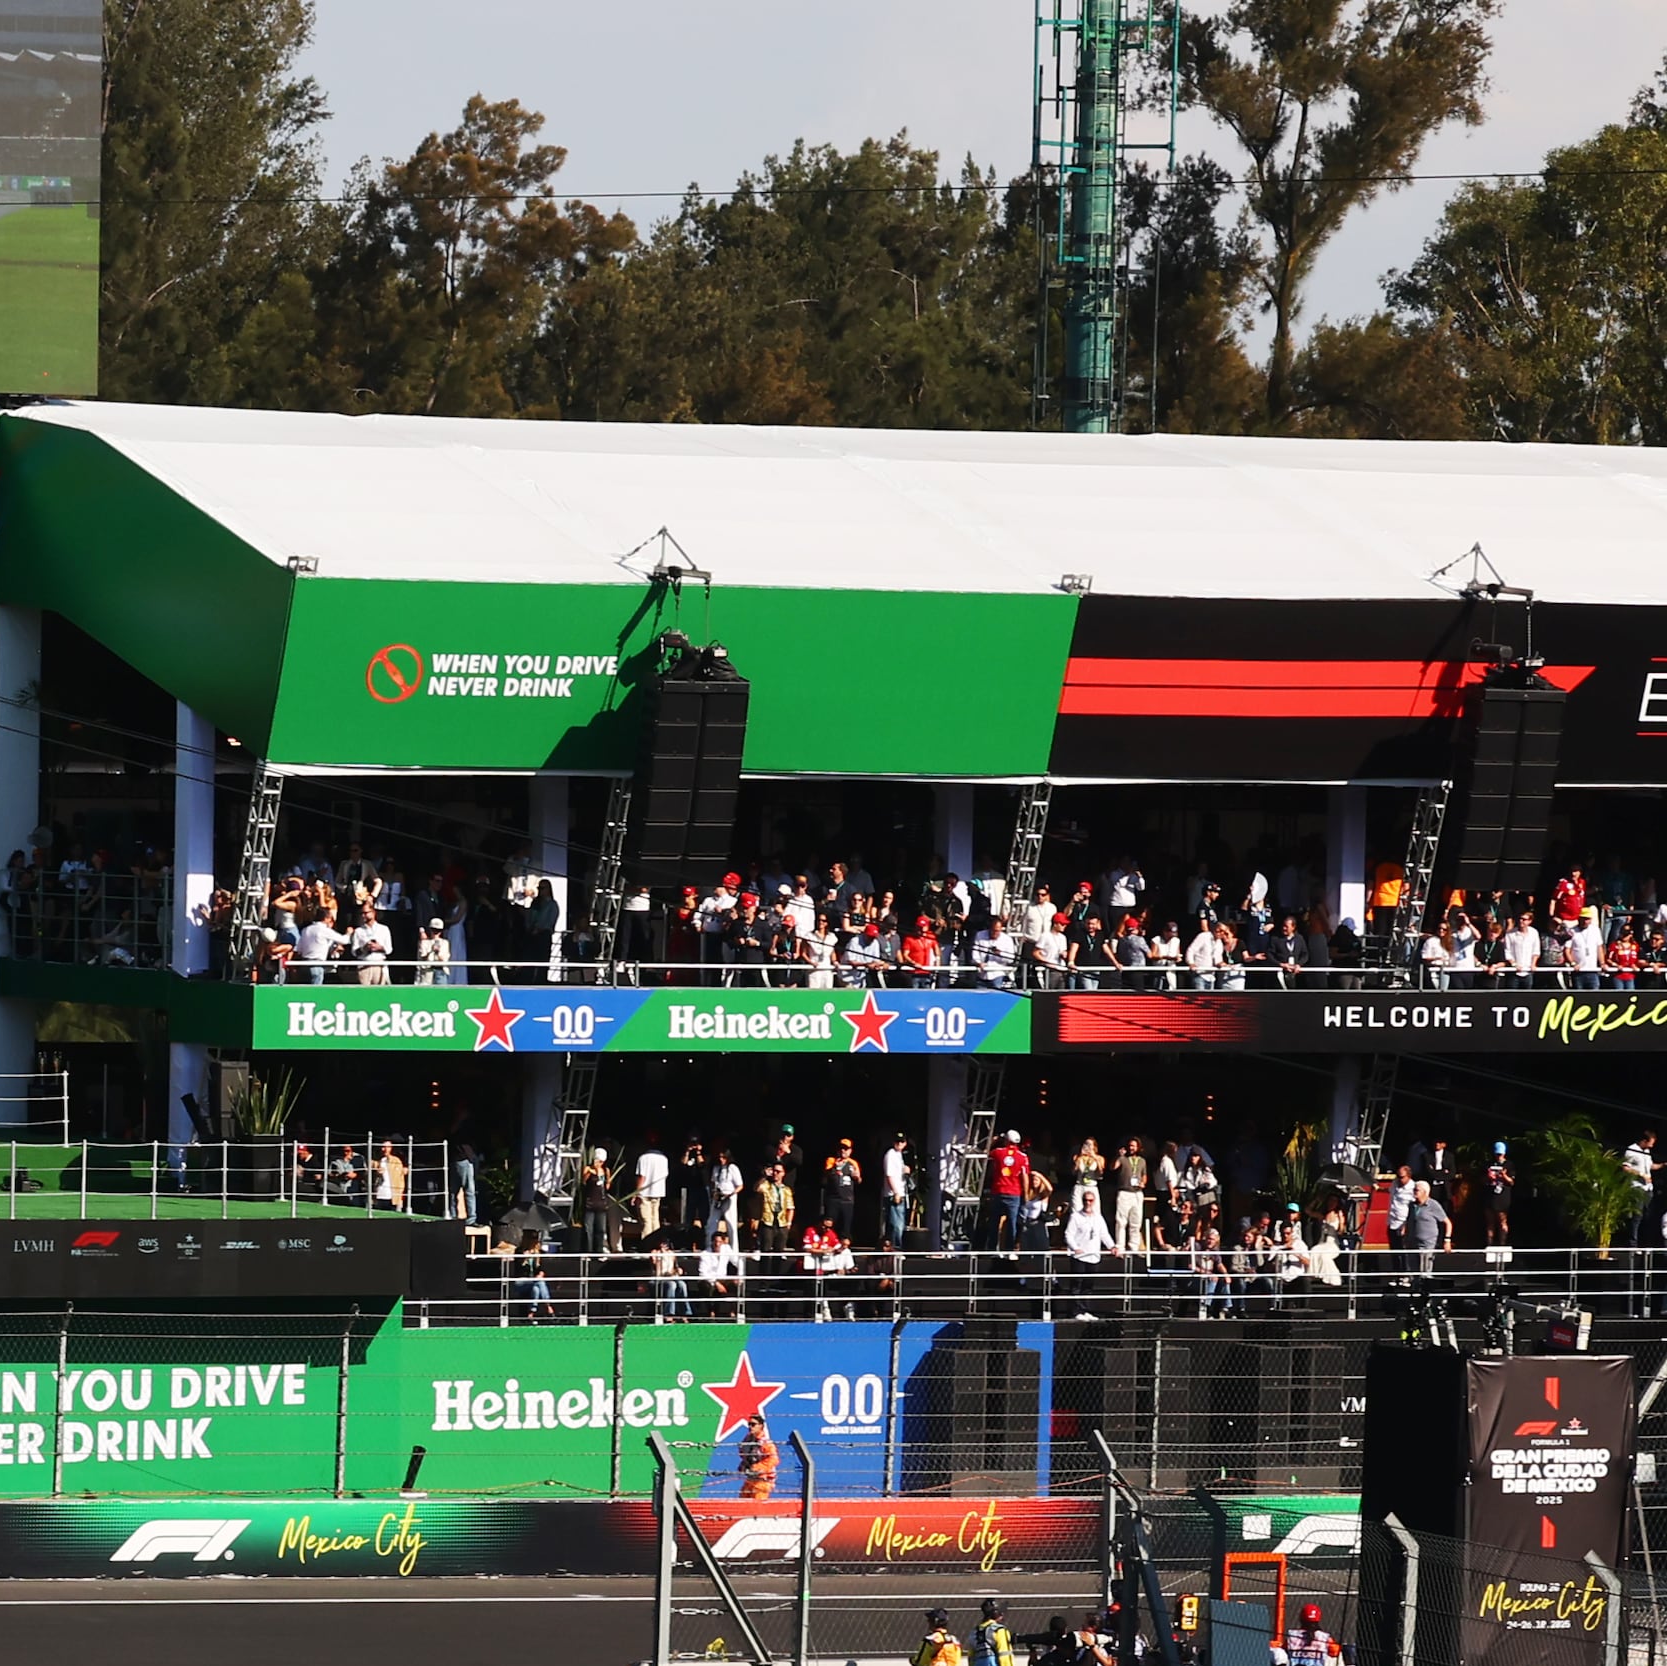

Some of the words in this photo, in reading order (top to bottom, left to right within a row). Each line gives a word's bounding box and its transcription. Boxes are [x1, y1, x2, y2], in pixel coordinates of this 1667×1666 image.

[431, 654, 499, 675] WHEN
[505, 654, 551, 675] YOU
[556, 656, 619, 676] DRIVE
[428, 676, 495, 697] NEVER
[503, 676, 573, 698] DRINK
[287, 1001, 457, 1038] Heineken
[669, 1003, 832, 1040] Heineken
[1324, 1006, 1473, 1028] WELCOME
[1491, 1006, 1531, 1028] TO
[14, 1240, 55, 1252] LVMH
[289, 1239, 311, 1248] MSC
[51, 1369, 152, 1412] YOU
[171, 1364, 305, 1408] DRIVE
[432, 1379, 689, 1432] Heineken
[62, 1418, 213, 1462] DRINK
[1491, 1449, 1541, 1464] GRAN
[1543, 1448, 1611, 1463] PREMIO
[1517, 1464, 1542, 1478] LA
[1543, 1464, 1608, 1478] CIUDAD
[1503, 1479, 1526, 1493] DE
[1535, 1496, 1563, 1504] 2025
[277, 1518, 370, 1565] Mexico
[375, 1504, 427, 1576] City
[866, 1515, 951, 1562] Mexico
[959, 1500, 1007, 1571] City
[1479, 1581, 1555, 1622] Mexico
[1557, 1576, 1607, 1630] City
